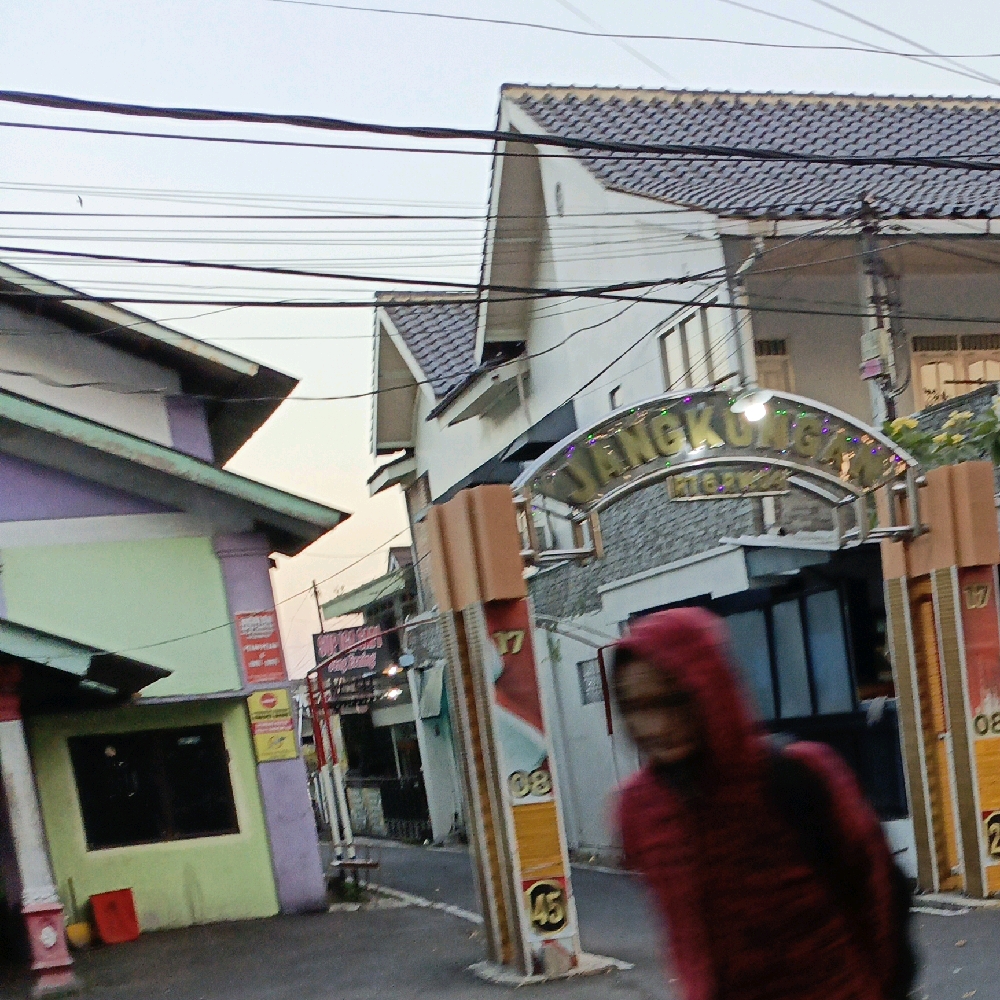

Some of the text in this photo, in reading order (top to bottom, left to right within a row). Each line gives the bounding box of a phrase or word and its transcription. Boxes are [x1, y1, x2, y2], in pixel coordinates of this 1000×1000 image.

[963, 583, 990, 609] 17
[492, 630, 525, 656] 17
[508, 770, 552, 798] 08
[532, 890, 564, 926] 45
